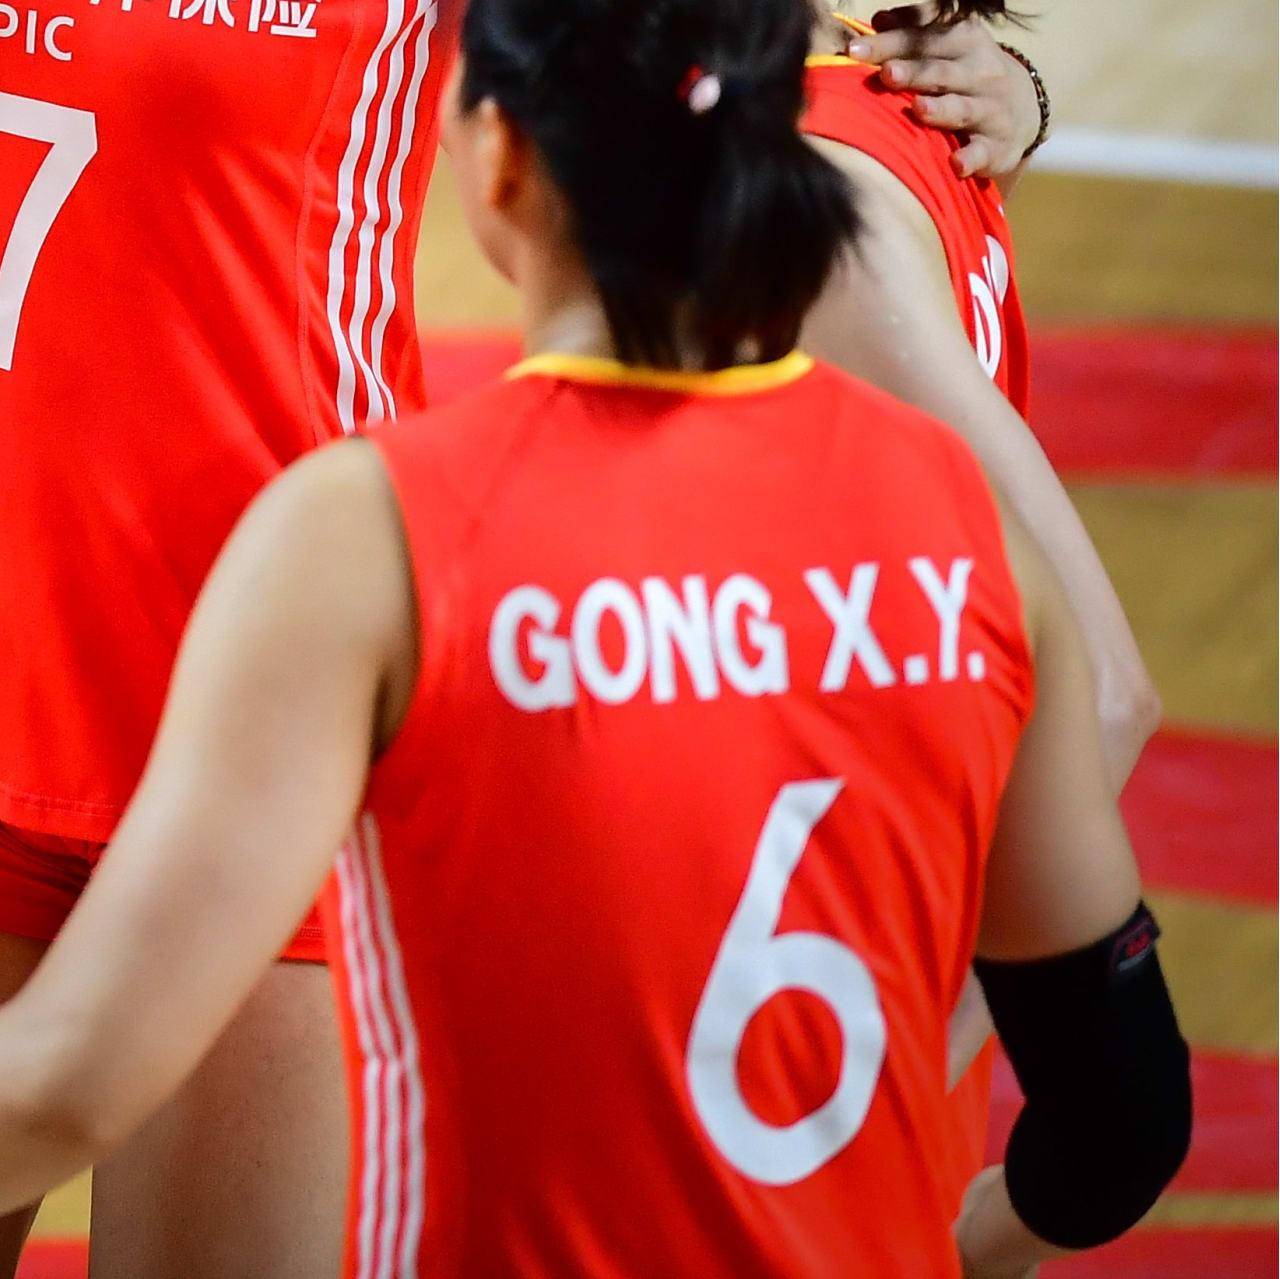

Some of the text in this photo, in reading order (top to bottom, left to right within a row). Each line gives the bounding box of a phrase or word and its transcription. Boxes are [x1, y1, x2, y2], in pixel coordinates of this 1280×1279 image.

[488, 556, 987, 713] GONG X.Y.
[686, 775, 888, 1186] 6
